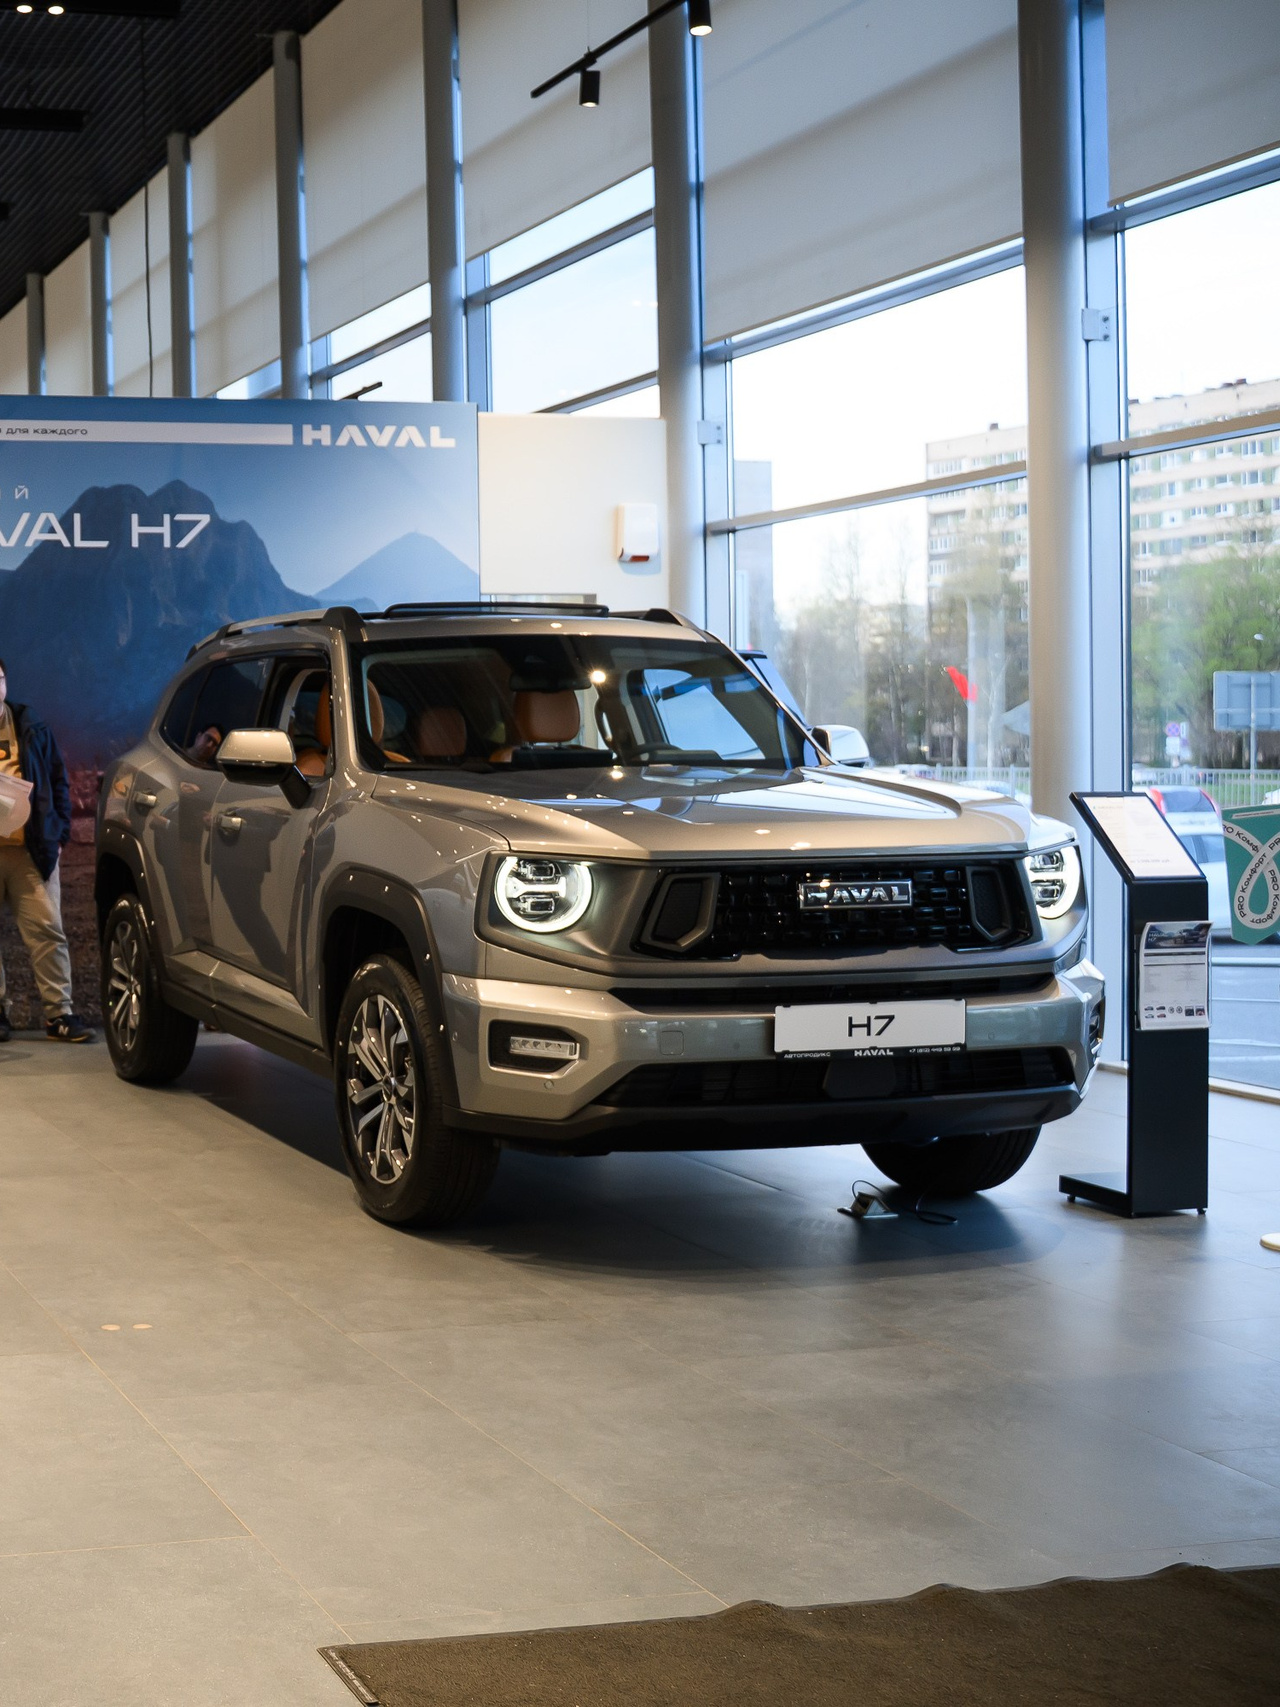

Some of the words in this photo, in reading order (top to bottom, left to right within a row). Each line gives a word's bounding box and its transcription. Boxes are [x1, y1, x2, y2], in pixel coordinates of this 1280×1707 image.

[6, 426, 29, 435] для
[33, 427, 88, 435] каждого
[302, 424, 456, 448] HAVAL
[131, 513, 211, 548] H7
[1240, 852, 1267, 893] Комфорт
[1268, 869, 1280, 891] PRO
[806, 886, 908, 903] HAVAL
[1238, 895, 1247, 918] PRO
[1250, 894, 1280, 924] Комфорт
[848, 1015, 895, 1037] H7
[854, 1048, 894, 1057] HAVAL
